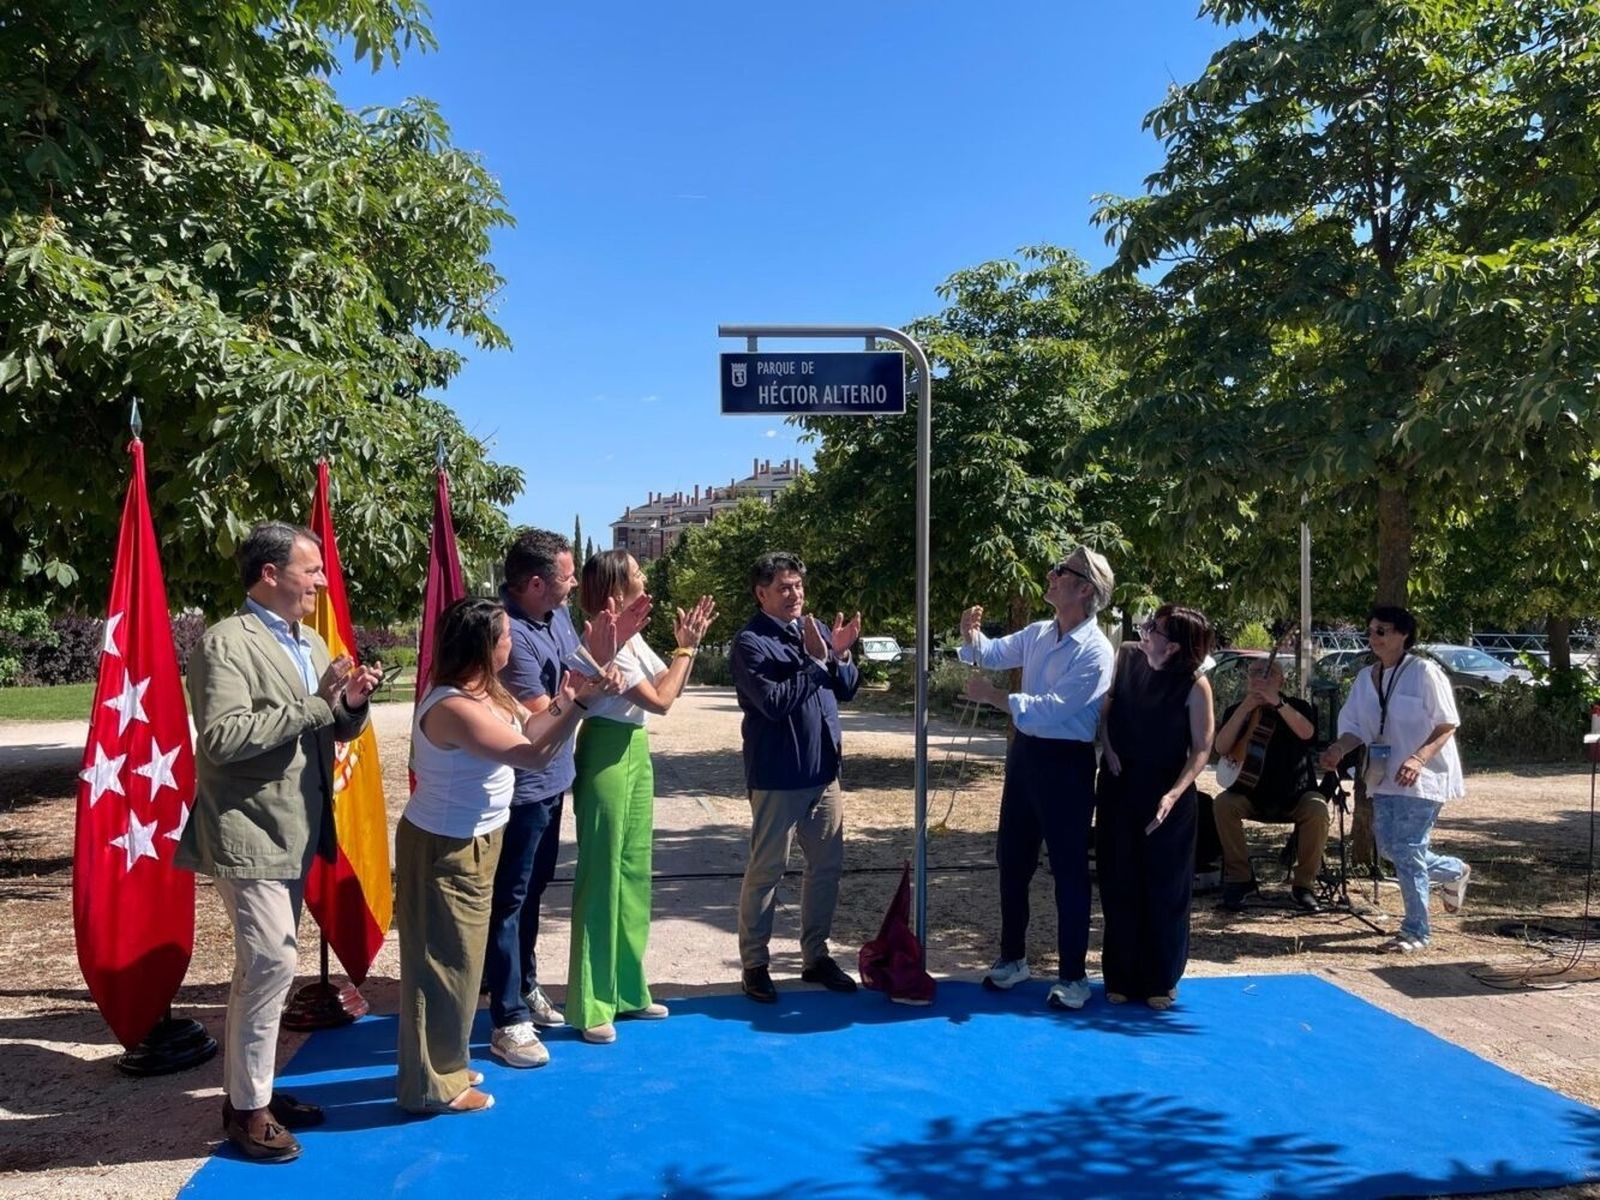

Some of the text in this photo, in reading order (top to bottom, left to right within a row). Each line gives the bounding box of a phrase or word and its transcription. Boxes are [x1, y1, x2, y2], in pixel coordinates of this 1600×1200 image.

[757, 361, 815, 375] PARQUE DE
[758, 381, 887, 404] HÉCTOR ALTERIO
